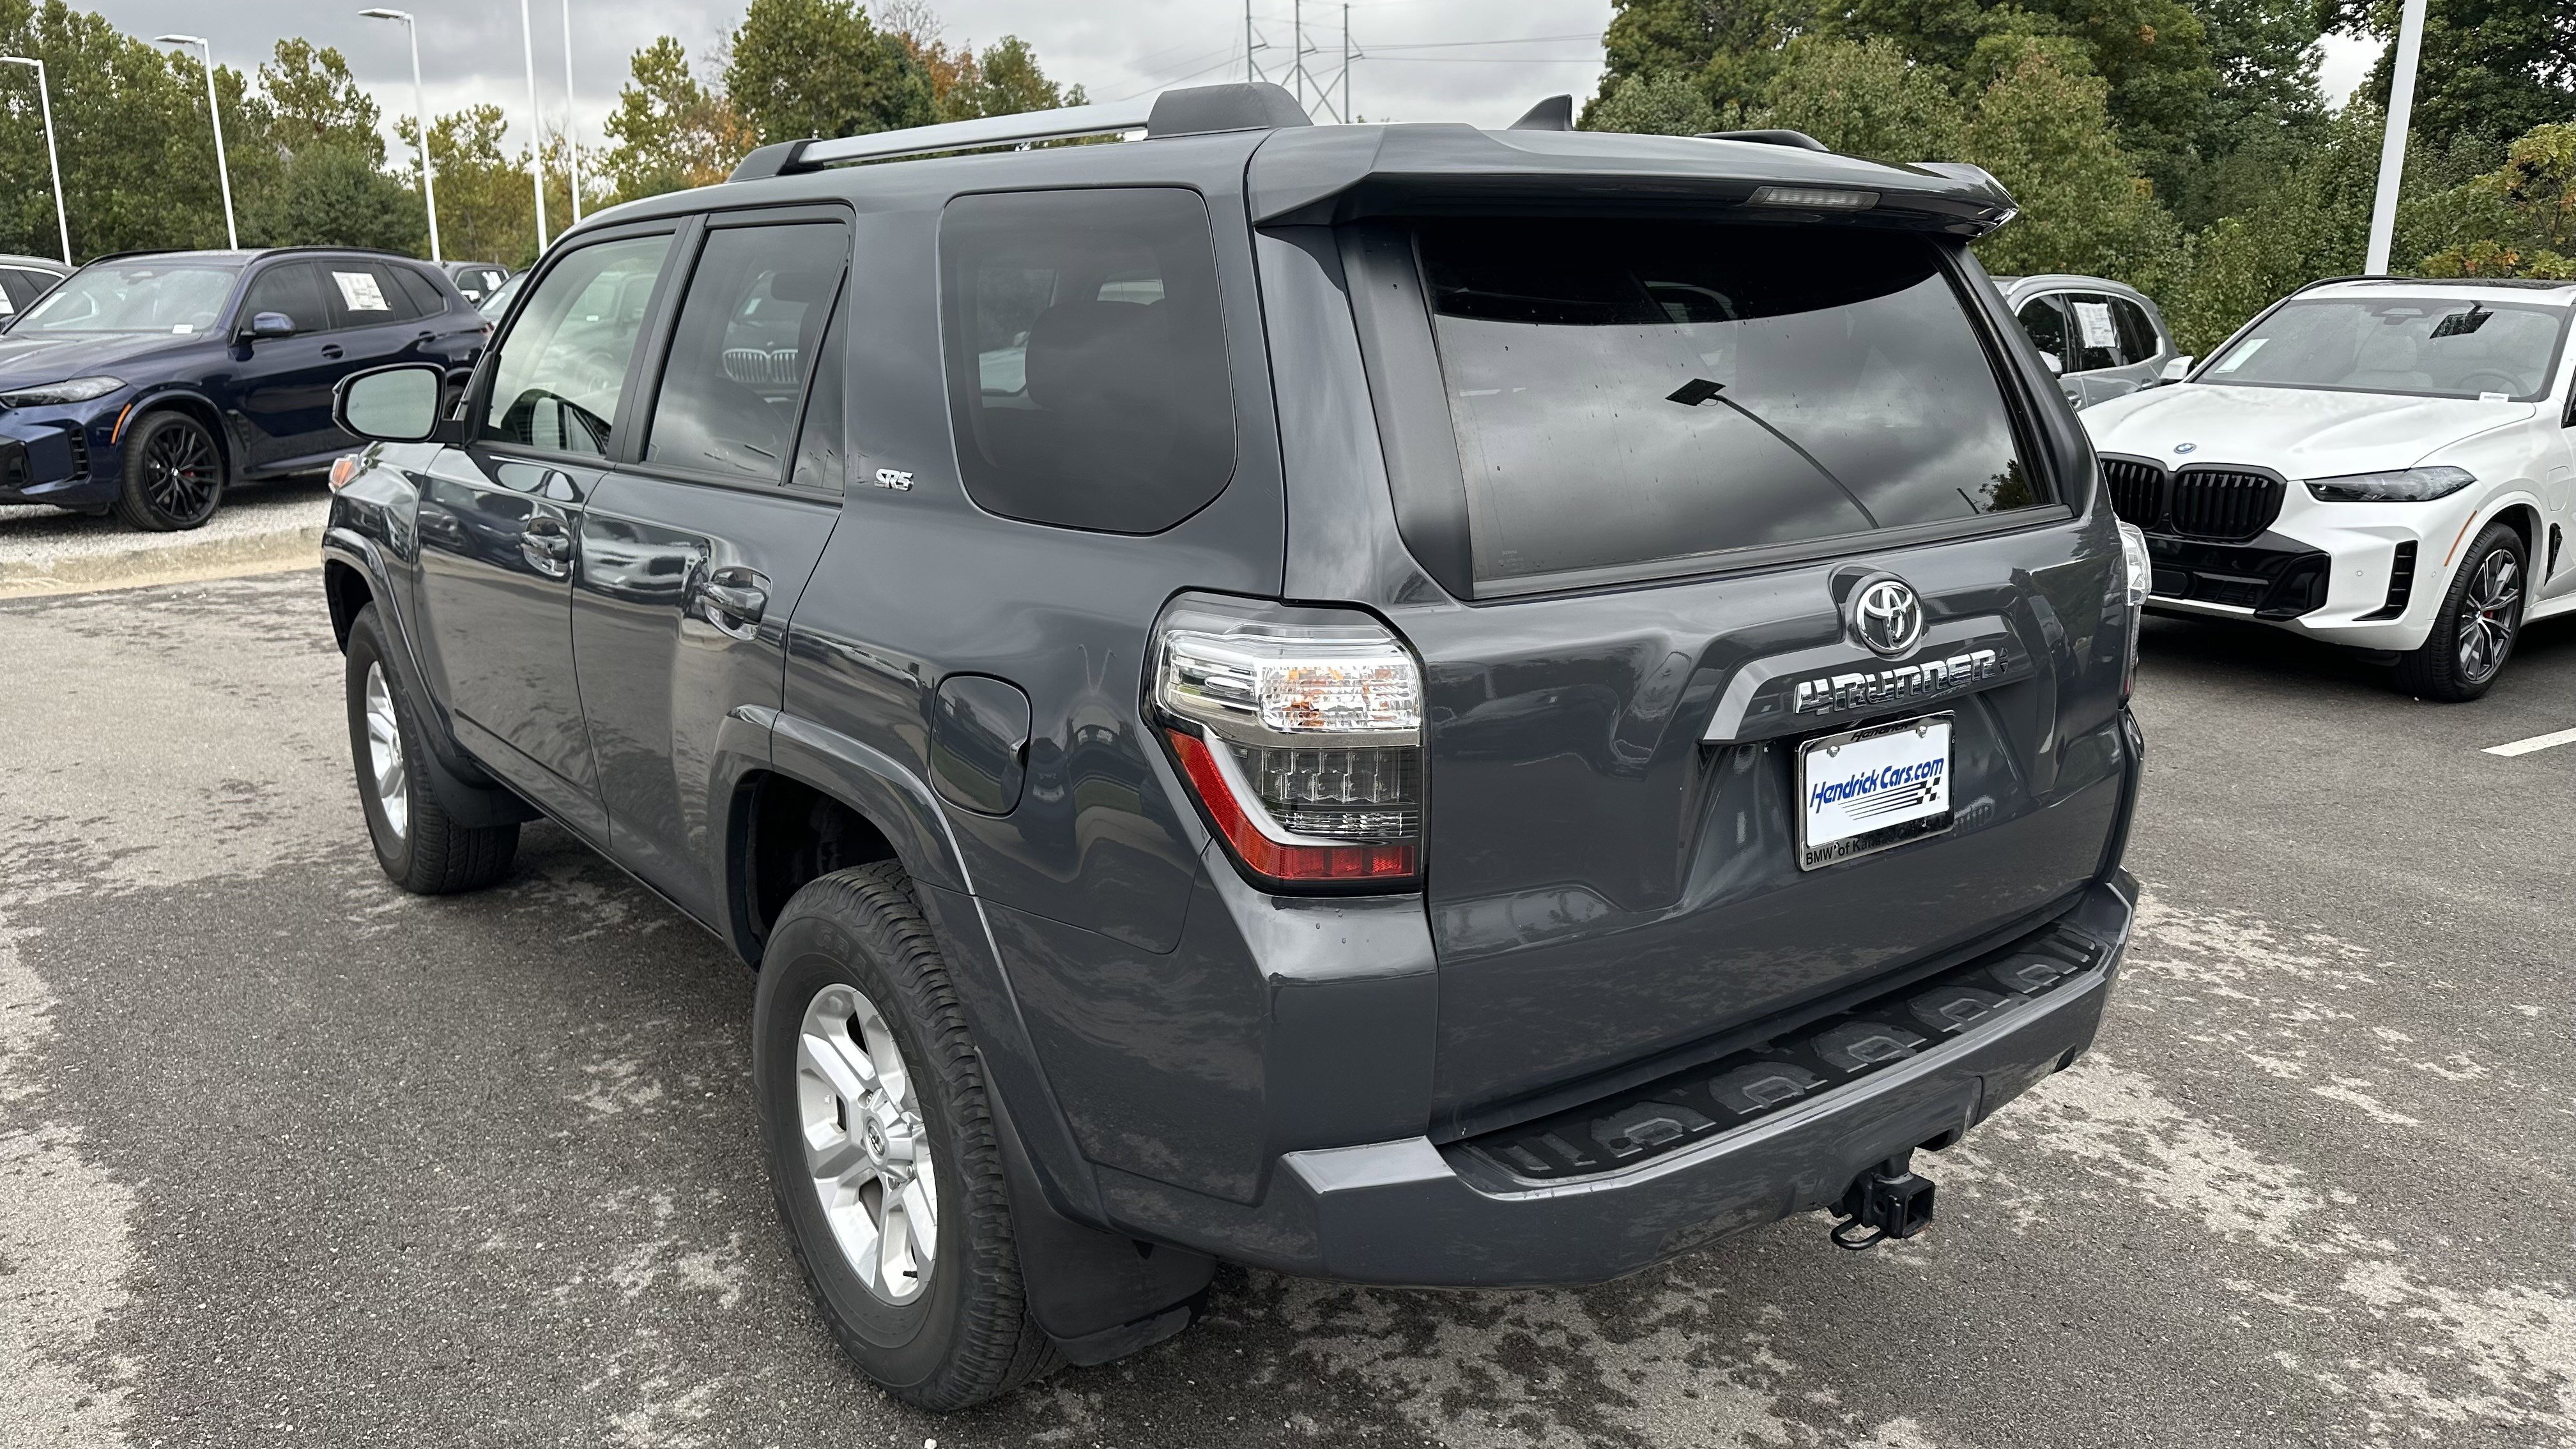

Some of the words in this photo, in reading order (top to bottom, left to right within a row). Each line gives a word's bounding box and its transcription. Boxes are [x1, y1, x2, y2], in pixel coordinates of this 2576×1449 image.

[874, 468, 914, 491] SR5
[1809, 769, 1880, 814] Hendrick
[1880, 758, 1944, 789] Cars.com
[1806, 847, 1832, 866] BMW
[1837, 841, 1850, 856] of
